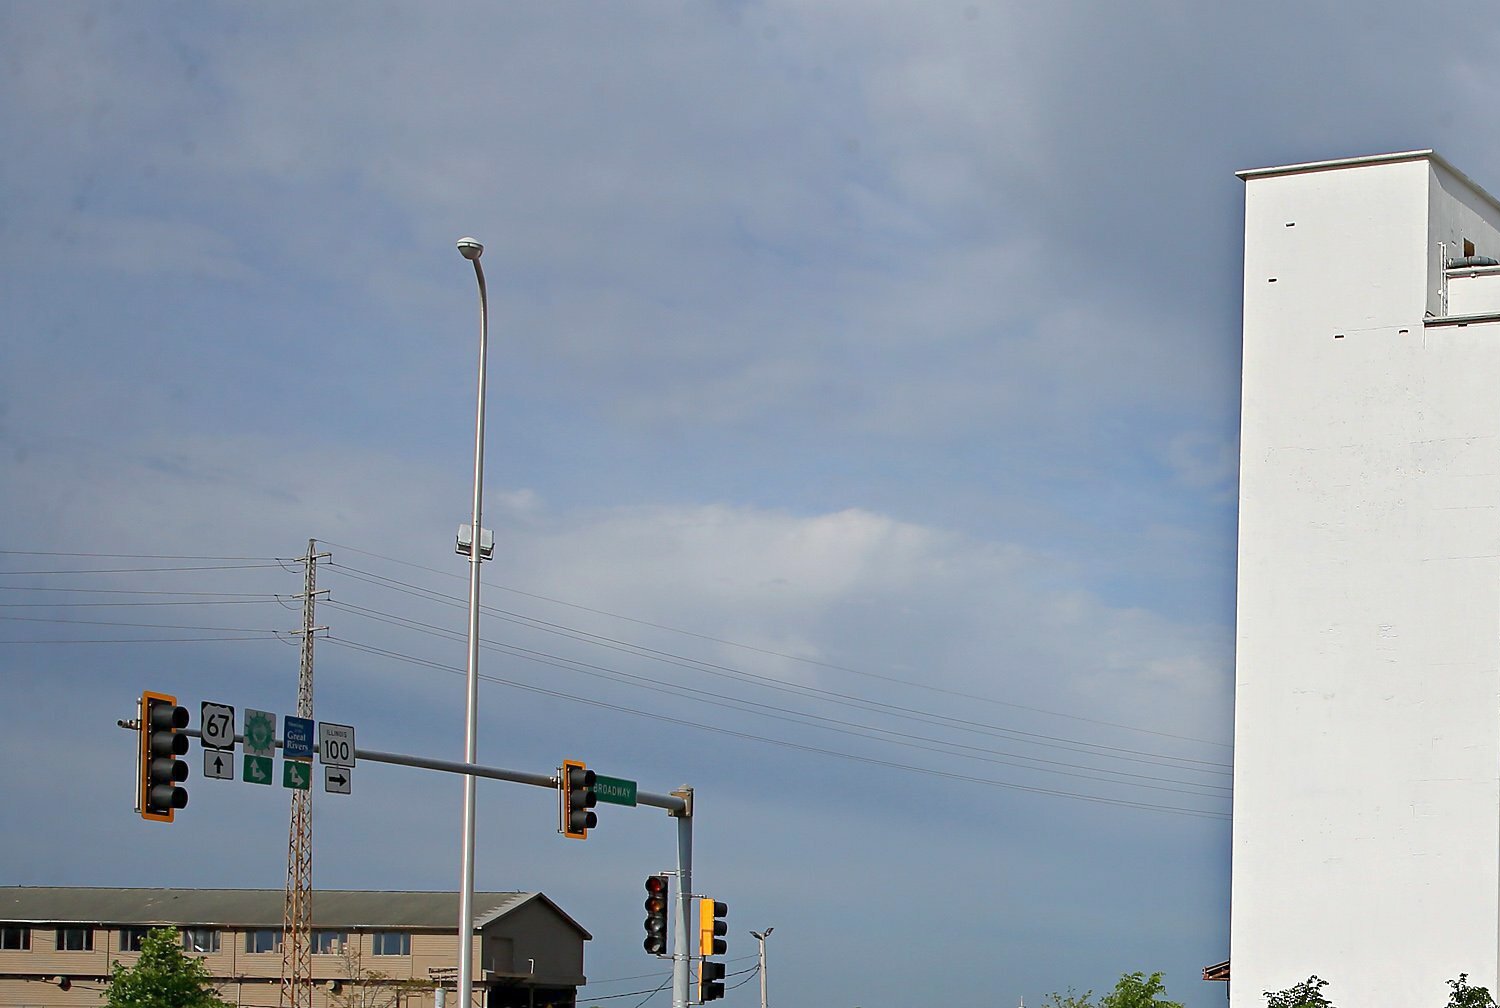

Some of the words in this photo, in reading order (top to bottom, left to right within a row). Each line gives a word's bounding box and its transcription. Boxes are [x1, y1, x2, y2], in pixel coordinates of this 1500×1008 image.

[206, 714, 230, 739] 67
[287, 730, 306, 741] Great
[326, 729, 348, 738] ILLINOIS
[286, 740, 309, 751] Rivers
[324, 740, 349, 761] 100
[593, 783, 631, 798] BROADWAY
